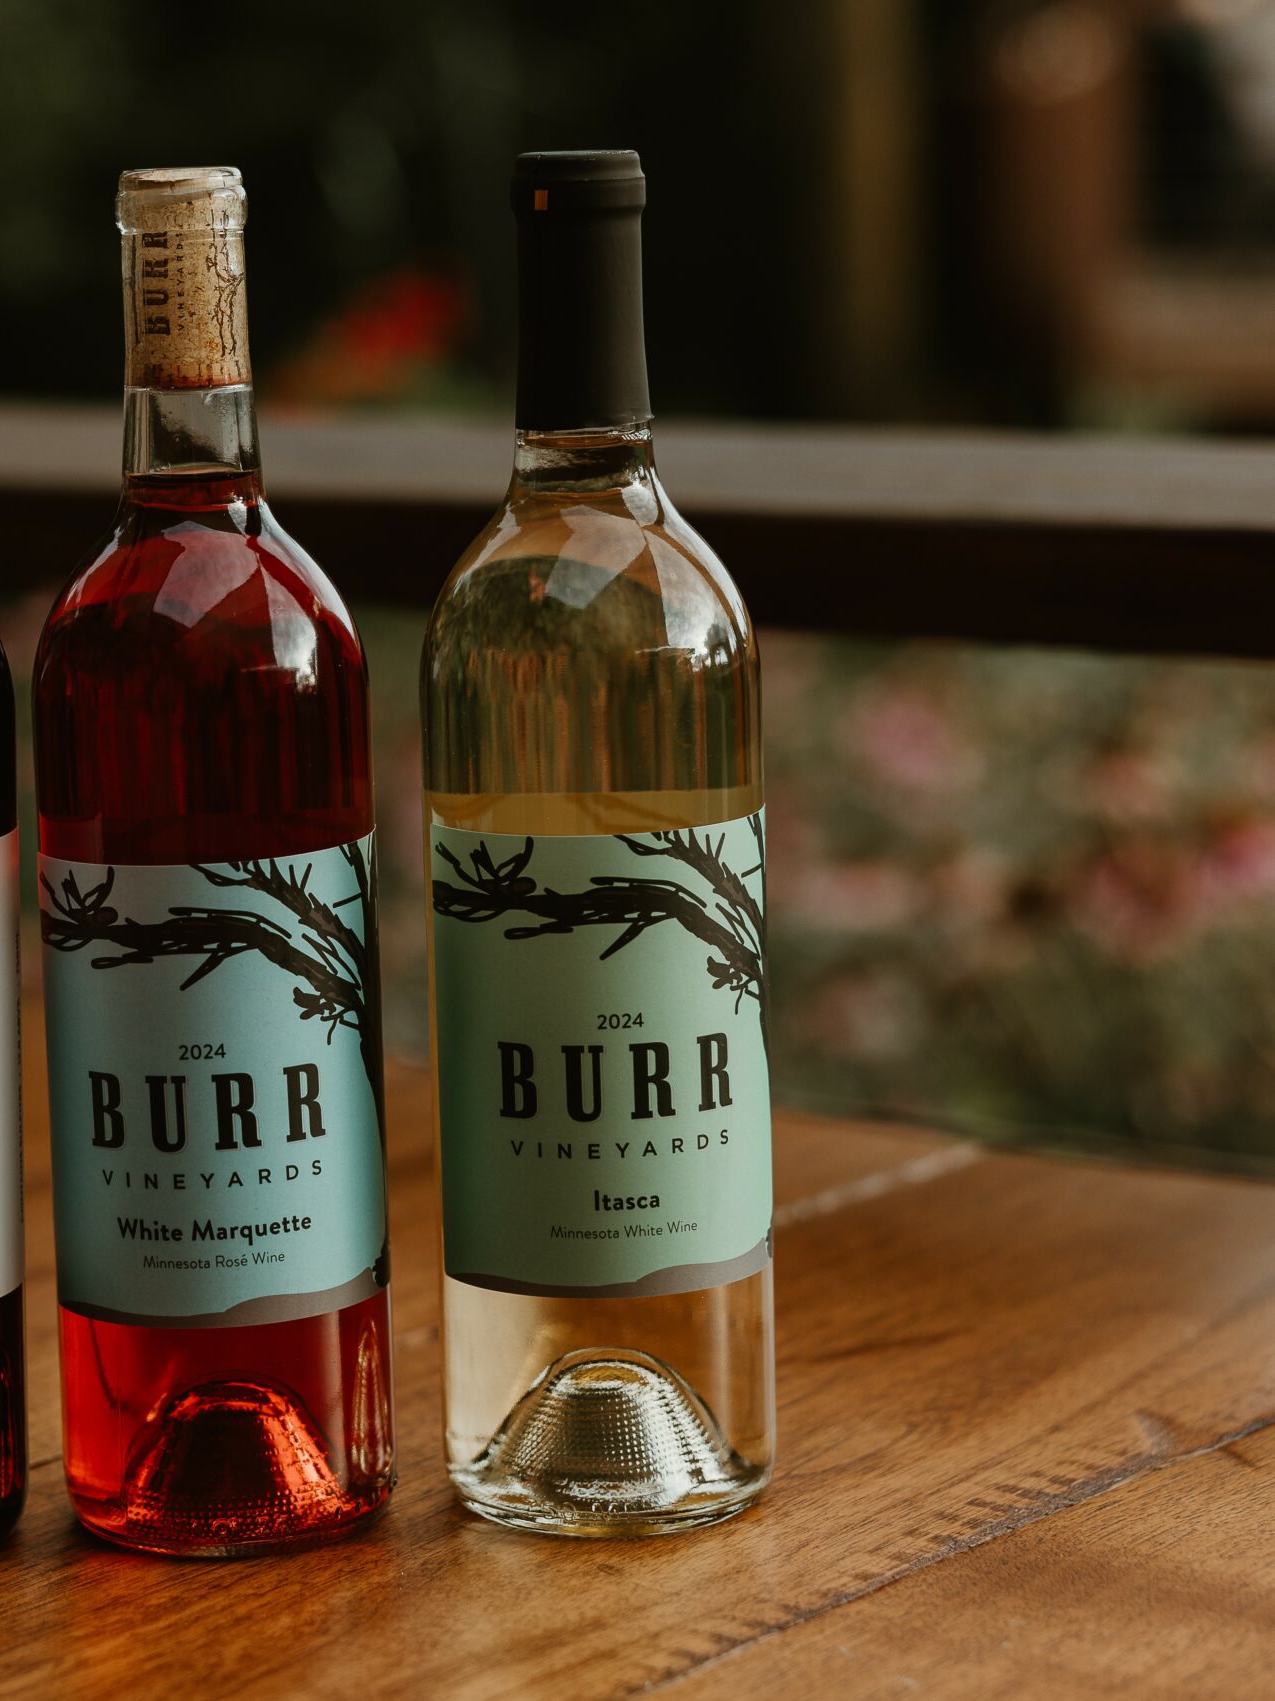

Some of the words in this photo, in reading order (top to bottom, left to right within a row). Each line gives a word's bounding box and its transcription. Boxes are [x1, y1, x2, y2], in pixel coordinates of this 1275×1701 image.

[597, 1013, 644, 1030] 2024
[178, 1043, 227, 1060] 2024
[497, 1032, 733, 1123] BURR
[88, 1063, 327, 1153] BURR
[511, 1129, 730, 1160] VINEYARDS
[102, 1160, 322, 1190] VINEYARDS
[593, 1190, 661, 1211] Itasca
[117, 1217, 183, 1242] White
[191, 1215, 312, 1246] Marquette
[550, 1225, 620, 1240] Minnesota
[624, 1224, 663, 1239] White
[667, 1221, 698, 1236] Wine
[143, 1255, 211, 1270] Minnesota
[215, 1254, 249, 1269] Rosé
[252, 1251, 286, 1266] Wine
